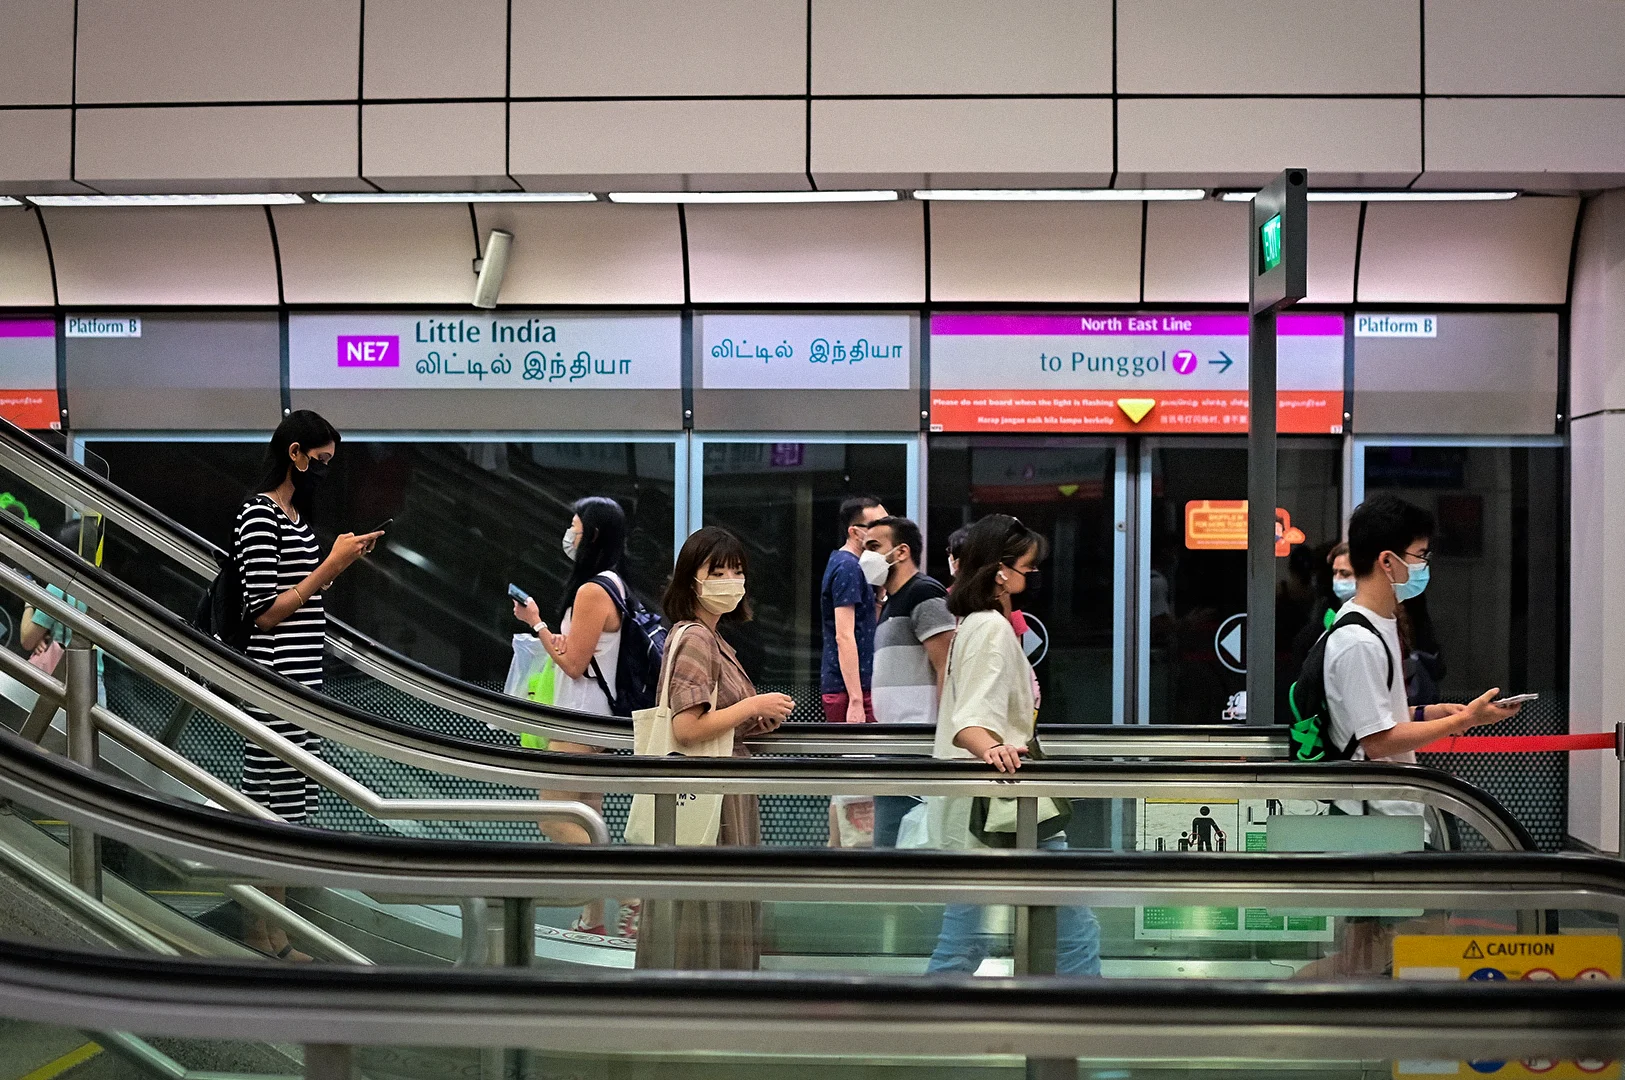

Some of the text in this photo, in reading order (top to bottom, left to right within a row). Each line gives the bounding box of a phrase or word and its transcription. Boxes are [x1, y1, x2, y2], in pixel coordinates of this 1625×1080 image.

[69, 318, 137, 333] Platform B
[415, 318, 556, 343] Little India
[1081, 317, 1192, 331] North East Line
[1359, 317, 1433, 332] Platform B
[347, 341, 390, 362] NE7
[711, 338, 903, 365] லிட்டில் இந்தியா
[415, 350, 632, 383] லிட்டில் இந்தியா
[1040, 350, 1193, 377] to Punggol 7
[1053, 399, 1071, 407] light
[1082, 399, 1114, 407] flashing
[1486, 942, 1555, 956] CAUTION
